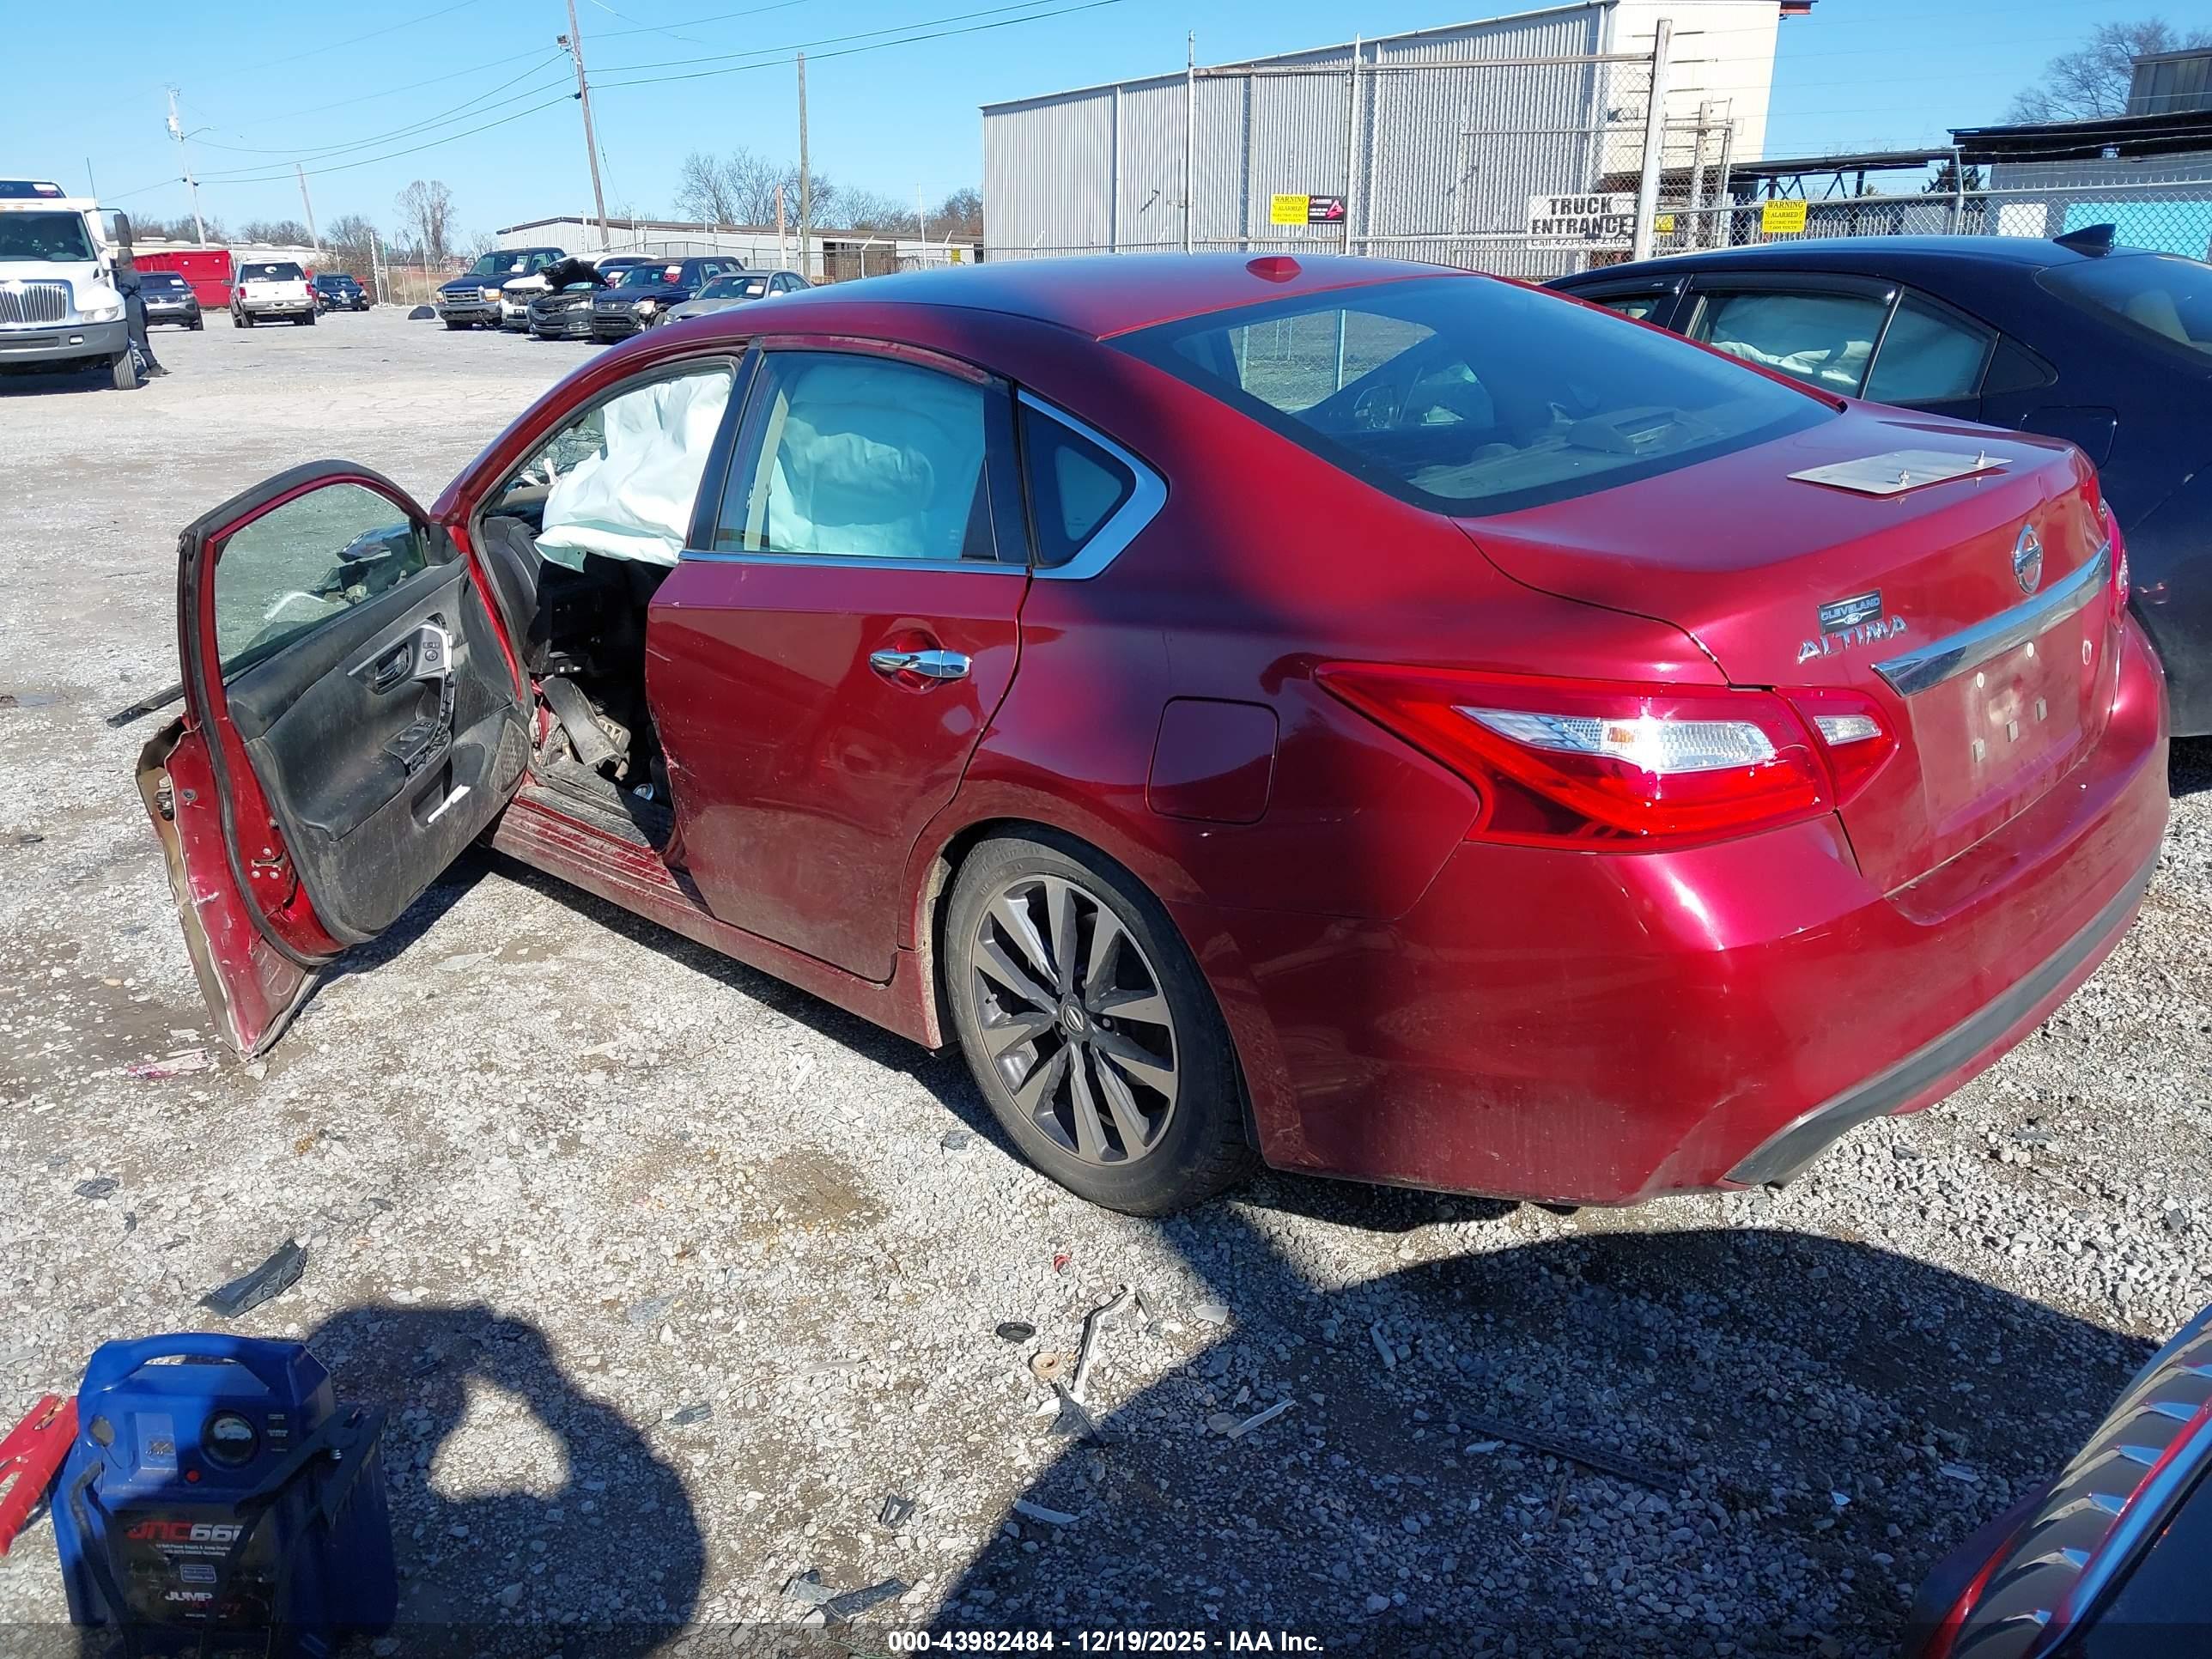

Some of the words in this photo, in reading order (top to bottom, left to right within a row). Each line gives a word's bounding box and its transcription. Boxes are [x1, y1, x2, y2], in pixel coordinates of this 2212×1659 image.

[1548, 197, 1613, 216] TRUCK
[1531, 216, 1629, 236] ENTRANCE
[1531, 239, 1552, 247] Call
[1820, 597, 1881, 621] CLEVELAND
[1796, 614, 1908, 665] ALTIMA
[165, 1592, 213, 1601] JUMP
